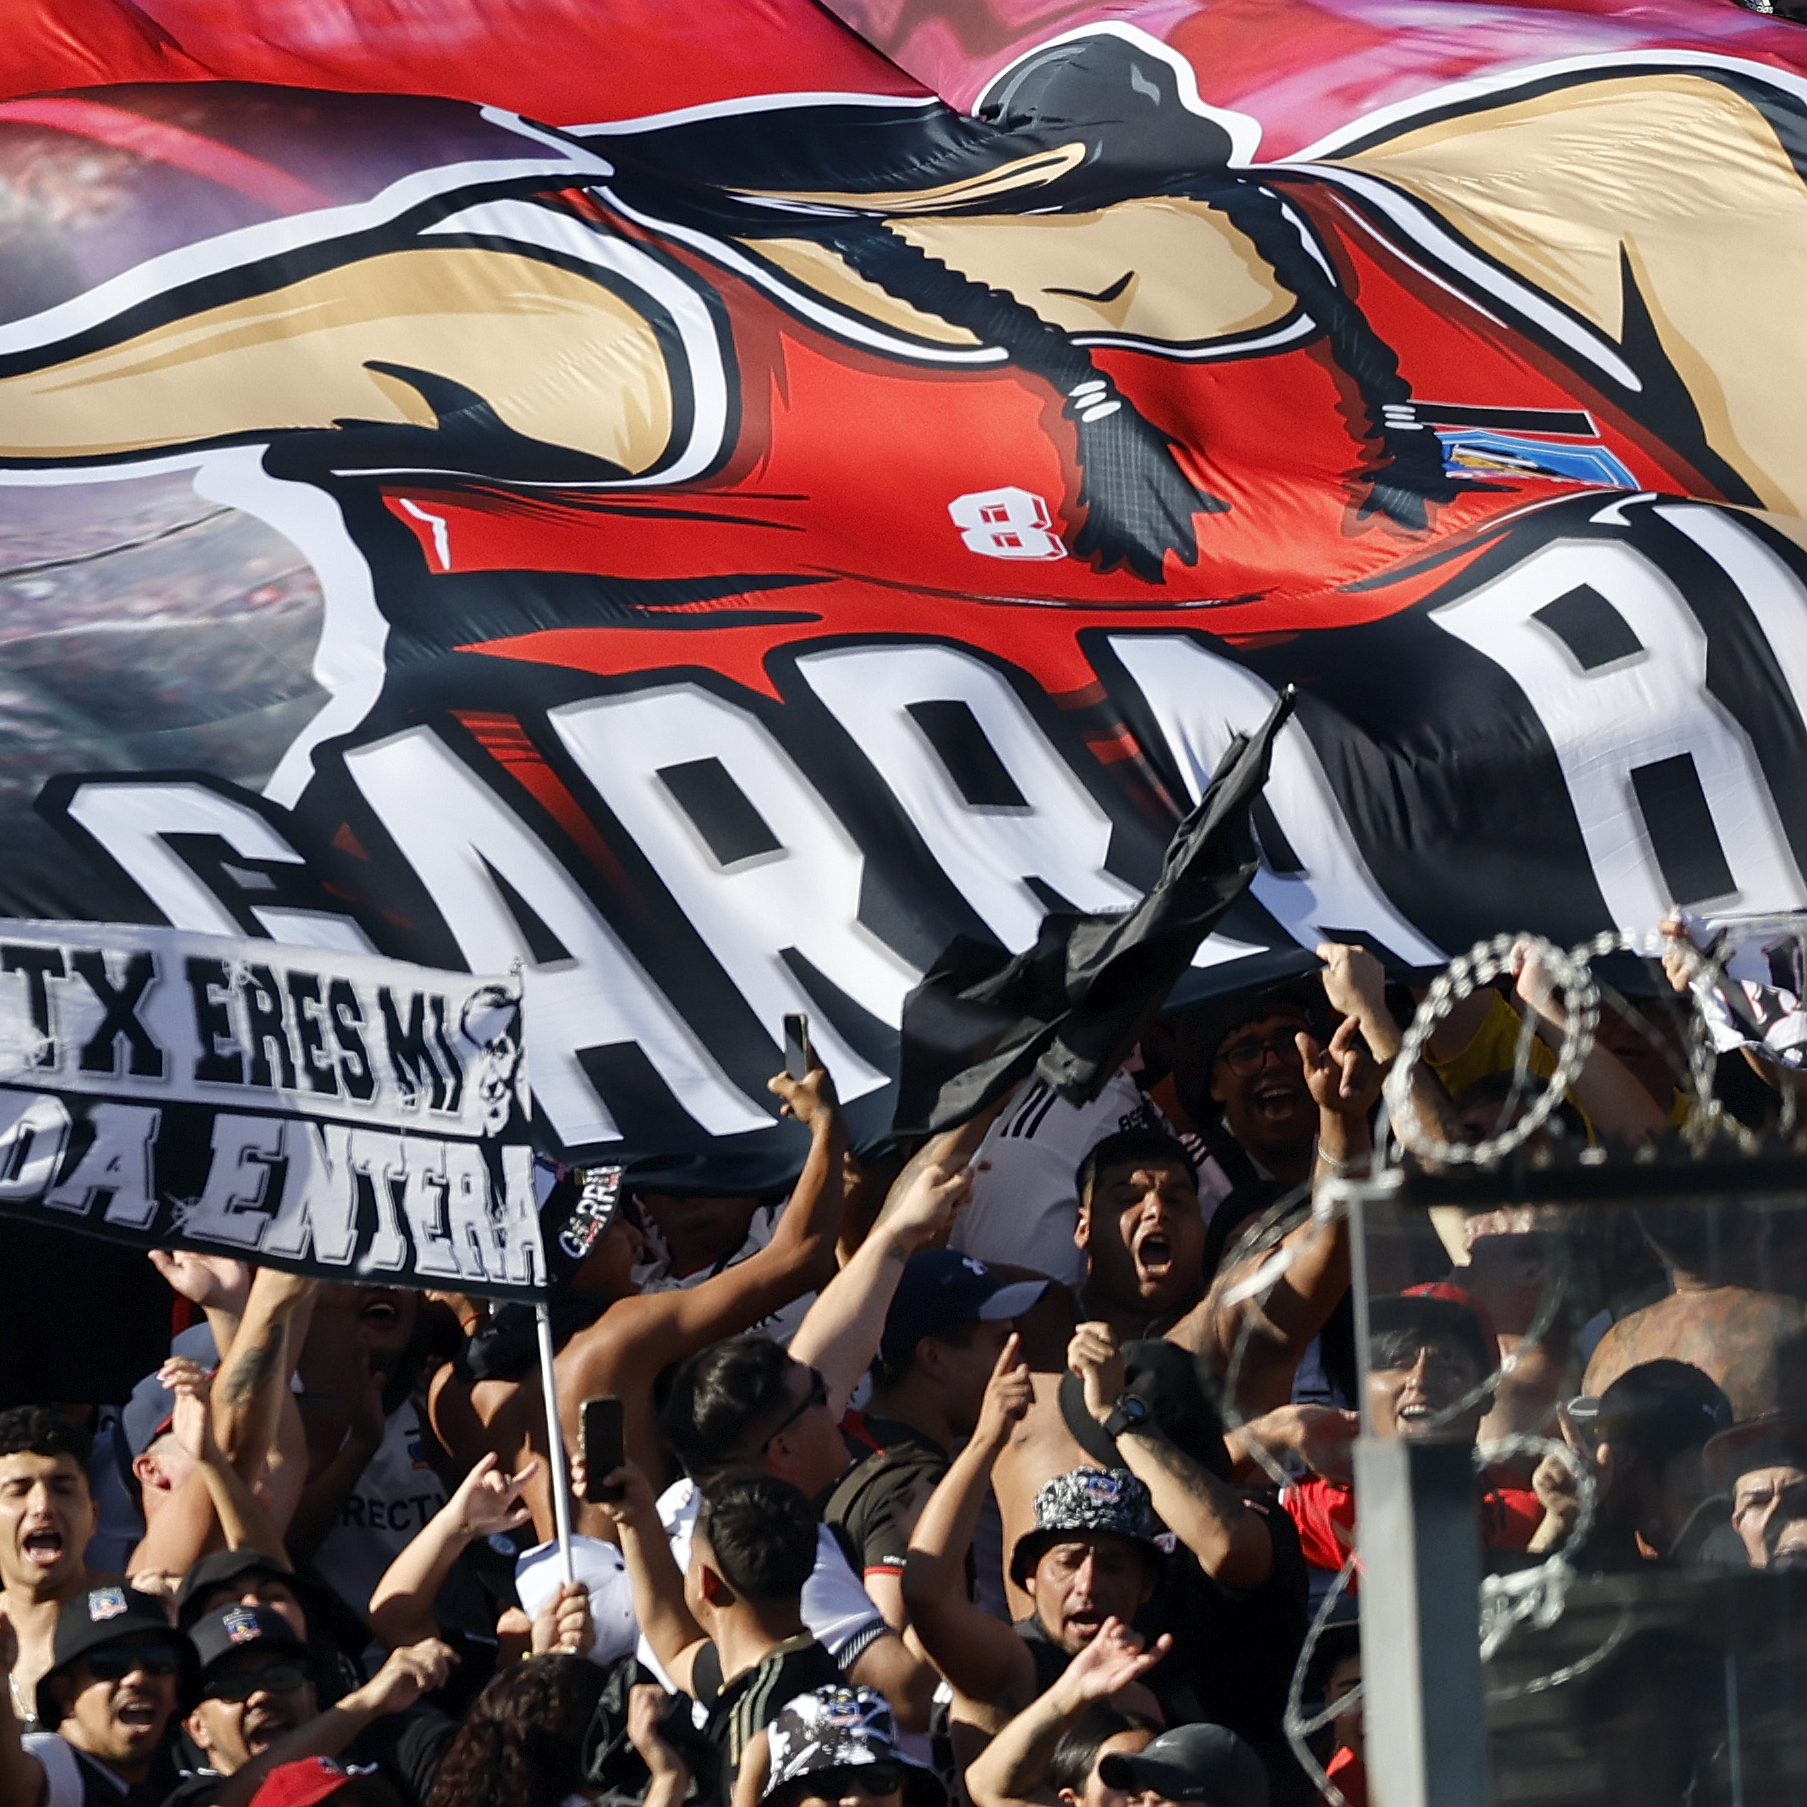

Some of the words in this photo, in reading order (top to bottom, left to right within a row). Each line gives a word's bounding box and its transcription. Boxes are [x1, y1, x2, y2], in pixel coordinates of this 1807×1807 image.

[0, 944, 170, 1086] TX
[191, 963, 373, 1103] ERES
[382, 981, 465, 1116] MI
[185, 1105, 549, 1286] ENTERA
